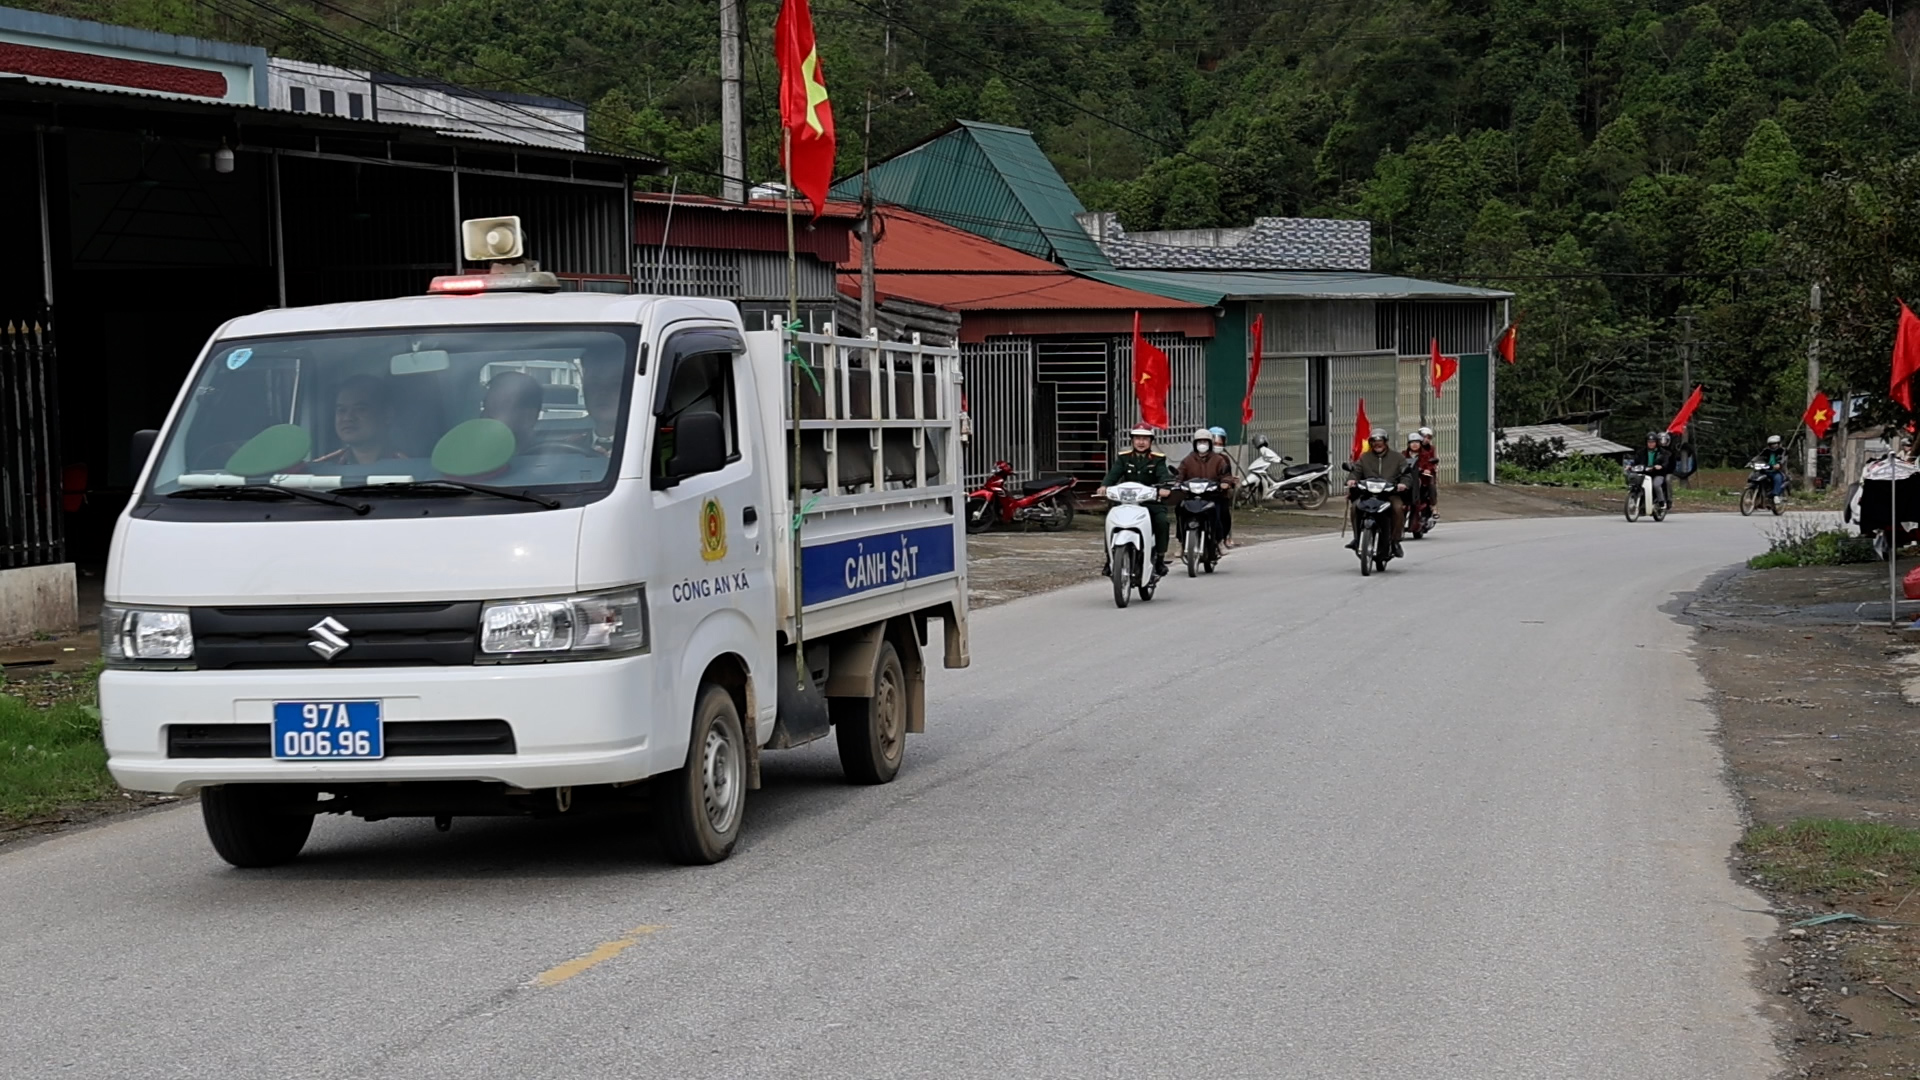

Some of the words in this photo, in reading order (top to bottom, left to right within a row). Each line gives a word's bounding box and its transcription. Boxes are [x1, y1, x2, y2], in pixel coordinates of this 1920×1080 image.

[845, 542, 887, 589] CẢNH
[891, 533, 919, 580] SẮT
[672, 577, 711, 603] CÔNG
[714, 575, 731, 595] AN
[302, 704, 350, 728] 97A
[284, 730, 371, 755] 006.96
